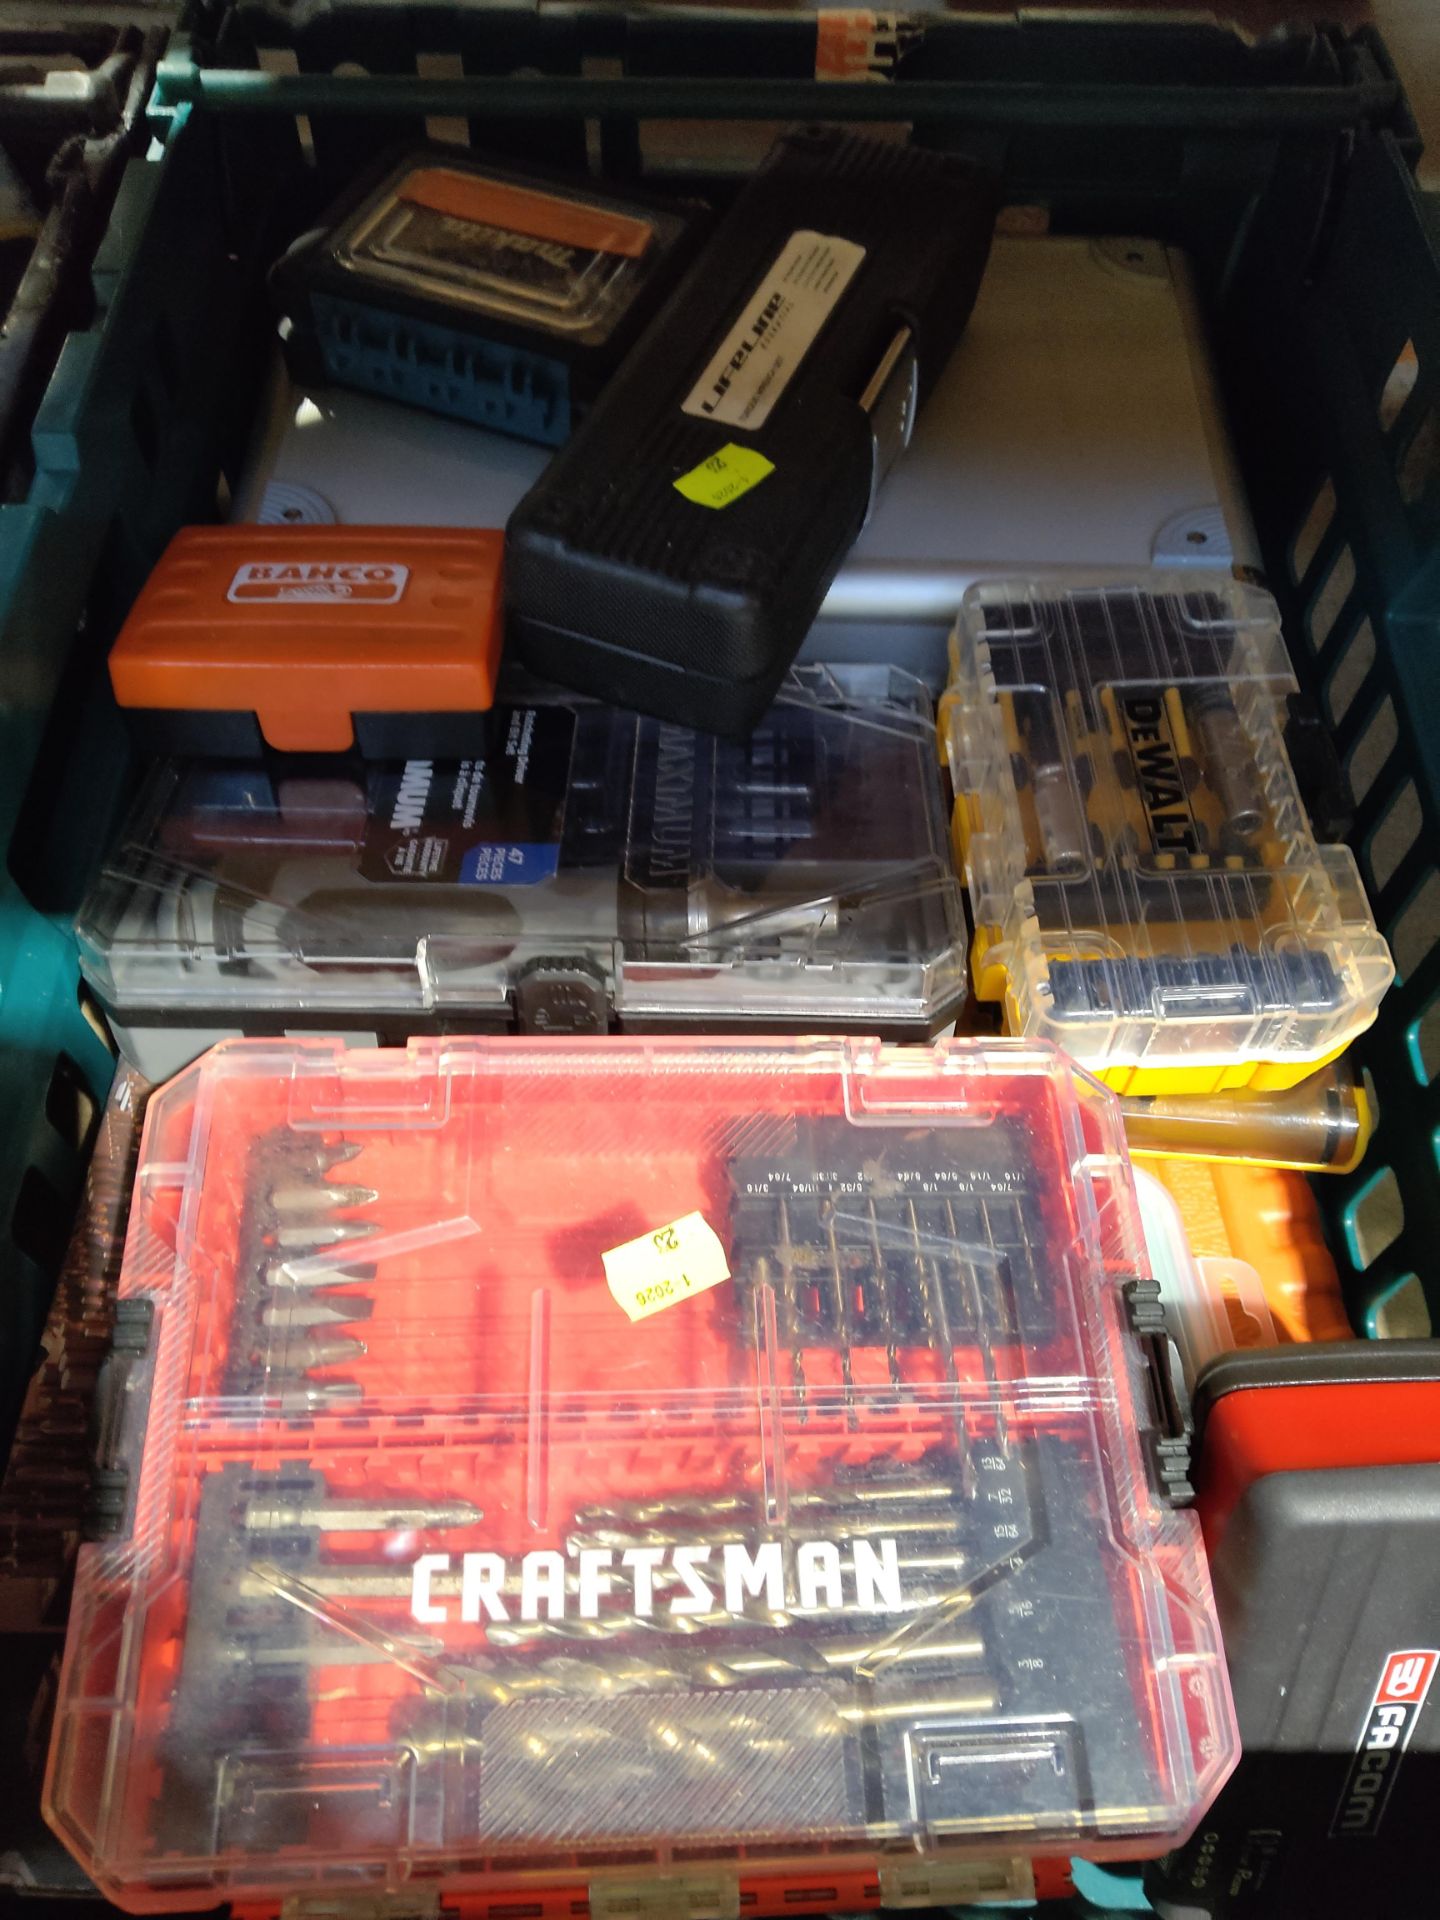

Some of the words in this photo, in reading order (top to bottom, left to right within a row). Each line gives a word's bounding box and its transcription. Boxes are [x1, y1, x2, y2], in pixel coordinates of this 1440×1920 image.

[248, 566, 395, 580] BAHCO
[508, 847, 524, 865] 47
[411, 1538, 902, 1624] CRAFTSMAN
